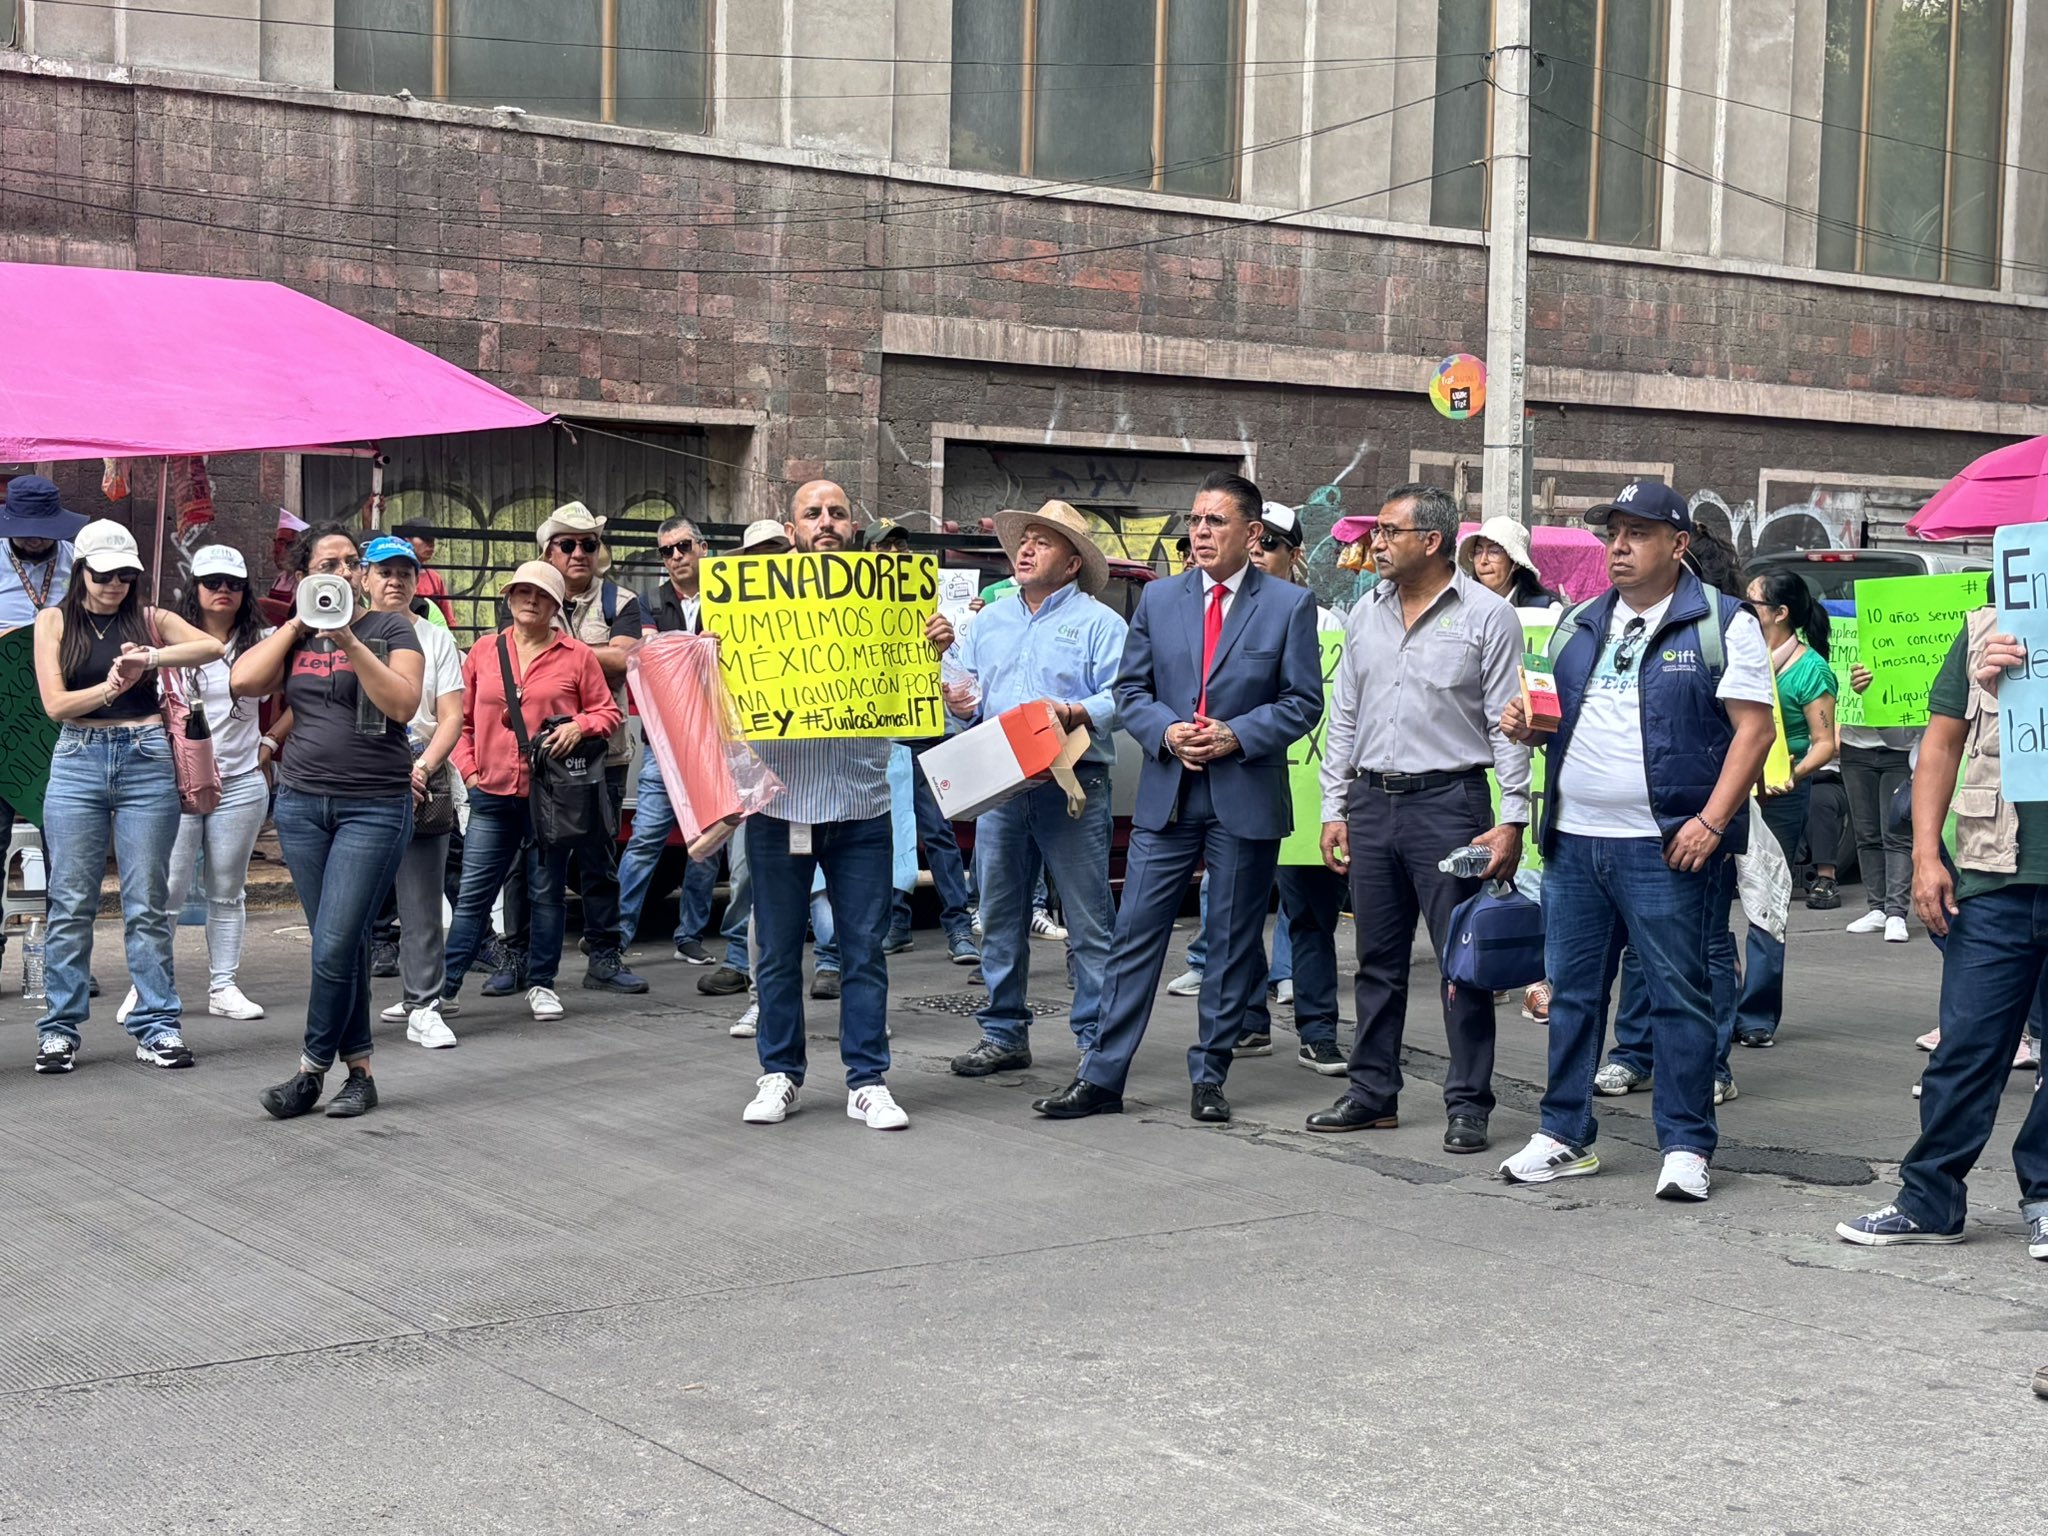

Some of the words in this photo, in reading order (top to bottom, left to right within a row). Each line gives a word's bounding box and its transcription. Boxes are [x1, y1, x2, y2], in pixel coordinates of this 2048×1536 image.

[706, 554, 936, 604] SENADORES
[708, 606, 873, 644] CUMPLIMOS
[1867, 608, 1883, 624] 10
[1889, 611, 1920, 624] años
[852, 640, 942, 670] MERECEMOS
[1677, 650, 1696, 663] ift
[1872, 637, 1895, 650] con
[780, 671, 900, 709] LIQUIDACIÓN
[904, 672, 942, 696] POR
